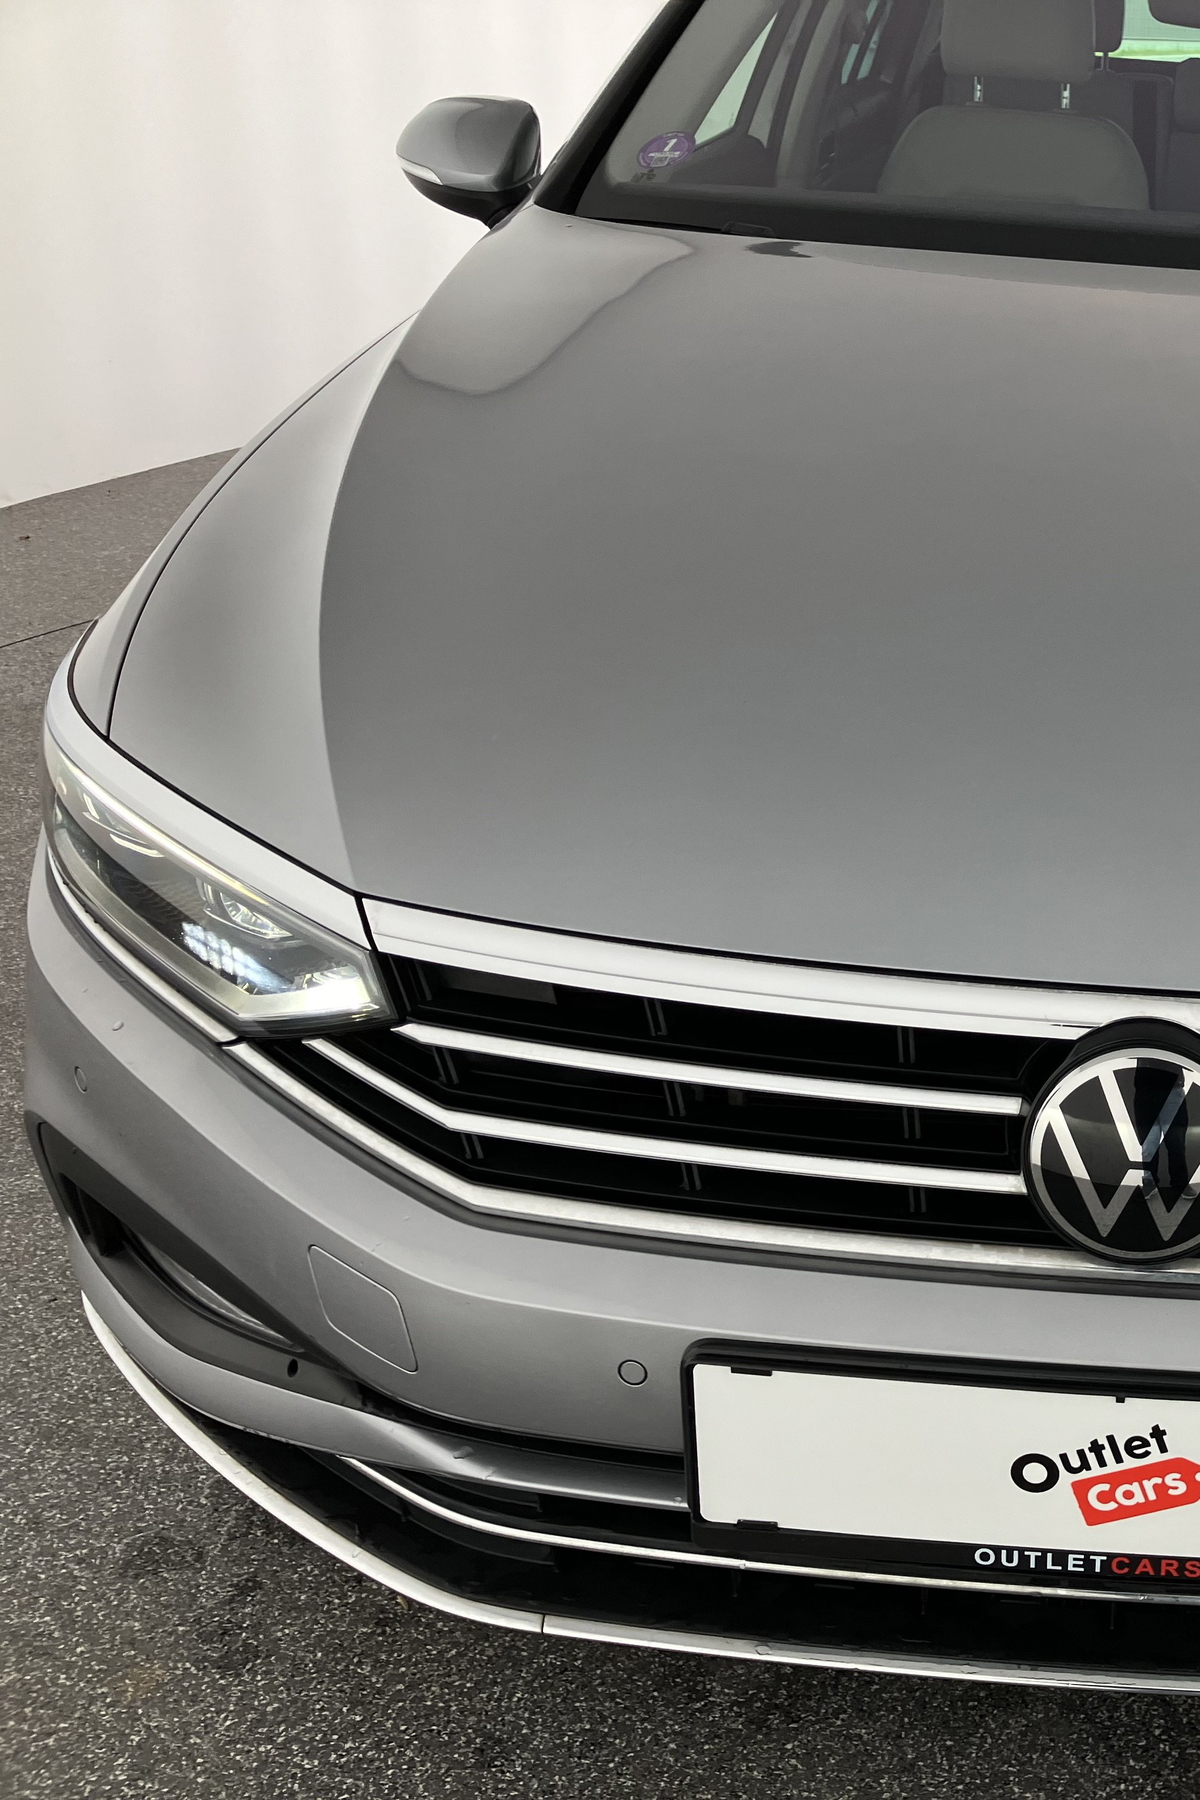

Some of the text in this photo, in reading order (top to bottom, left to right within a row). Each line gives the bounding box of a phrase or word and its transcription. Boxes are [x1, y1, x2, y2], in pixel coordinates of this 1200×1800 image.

[663, 138, 678, 152] 1
[1010, 1424, 1168, 1493] Outlet
[1087, 1472, 1187, 1511] Cars
